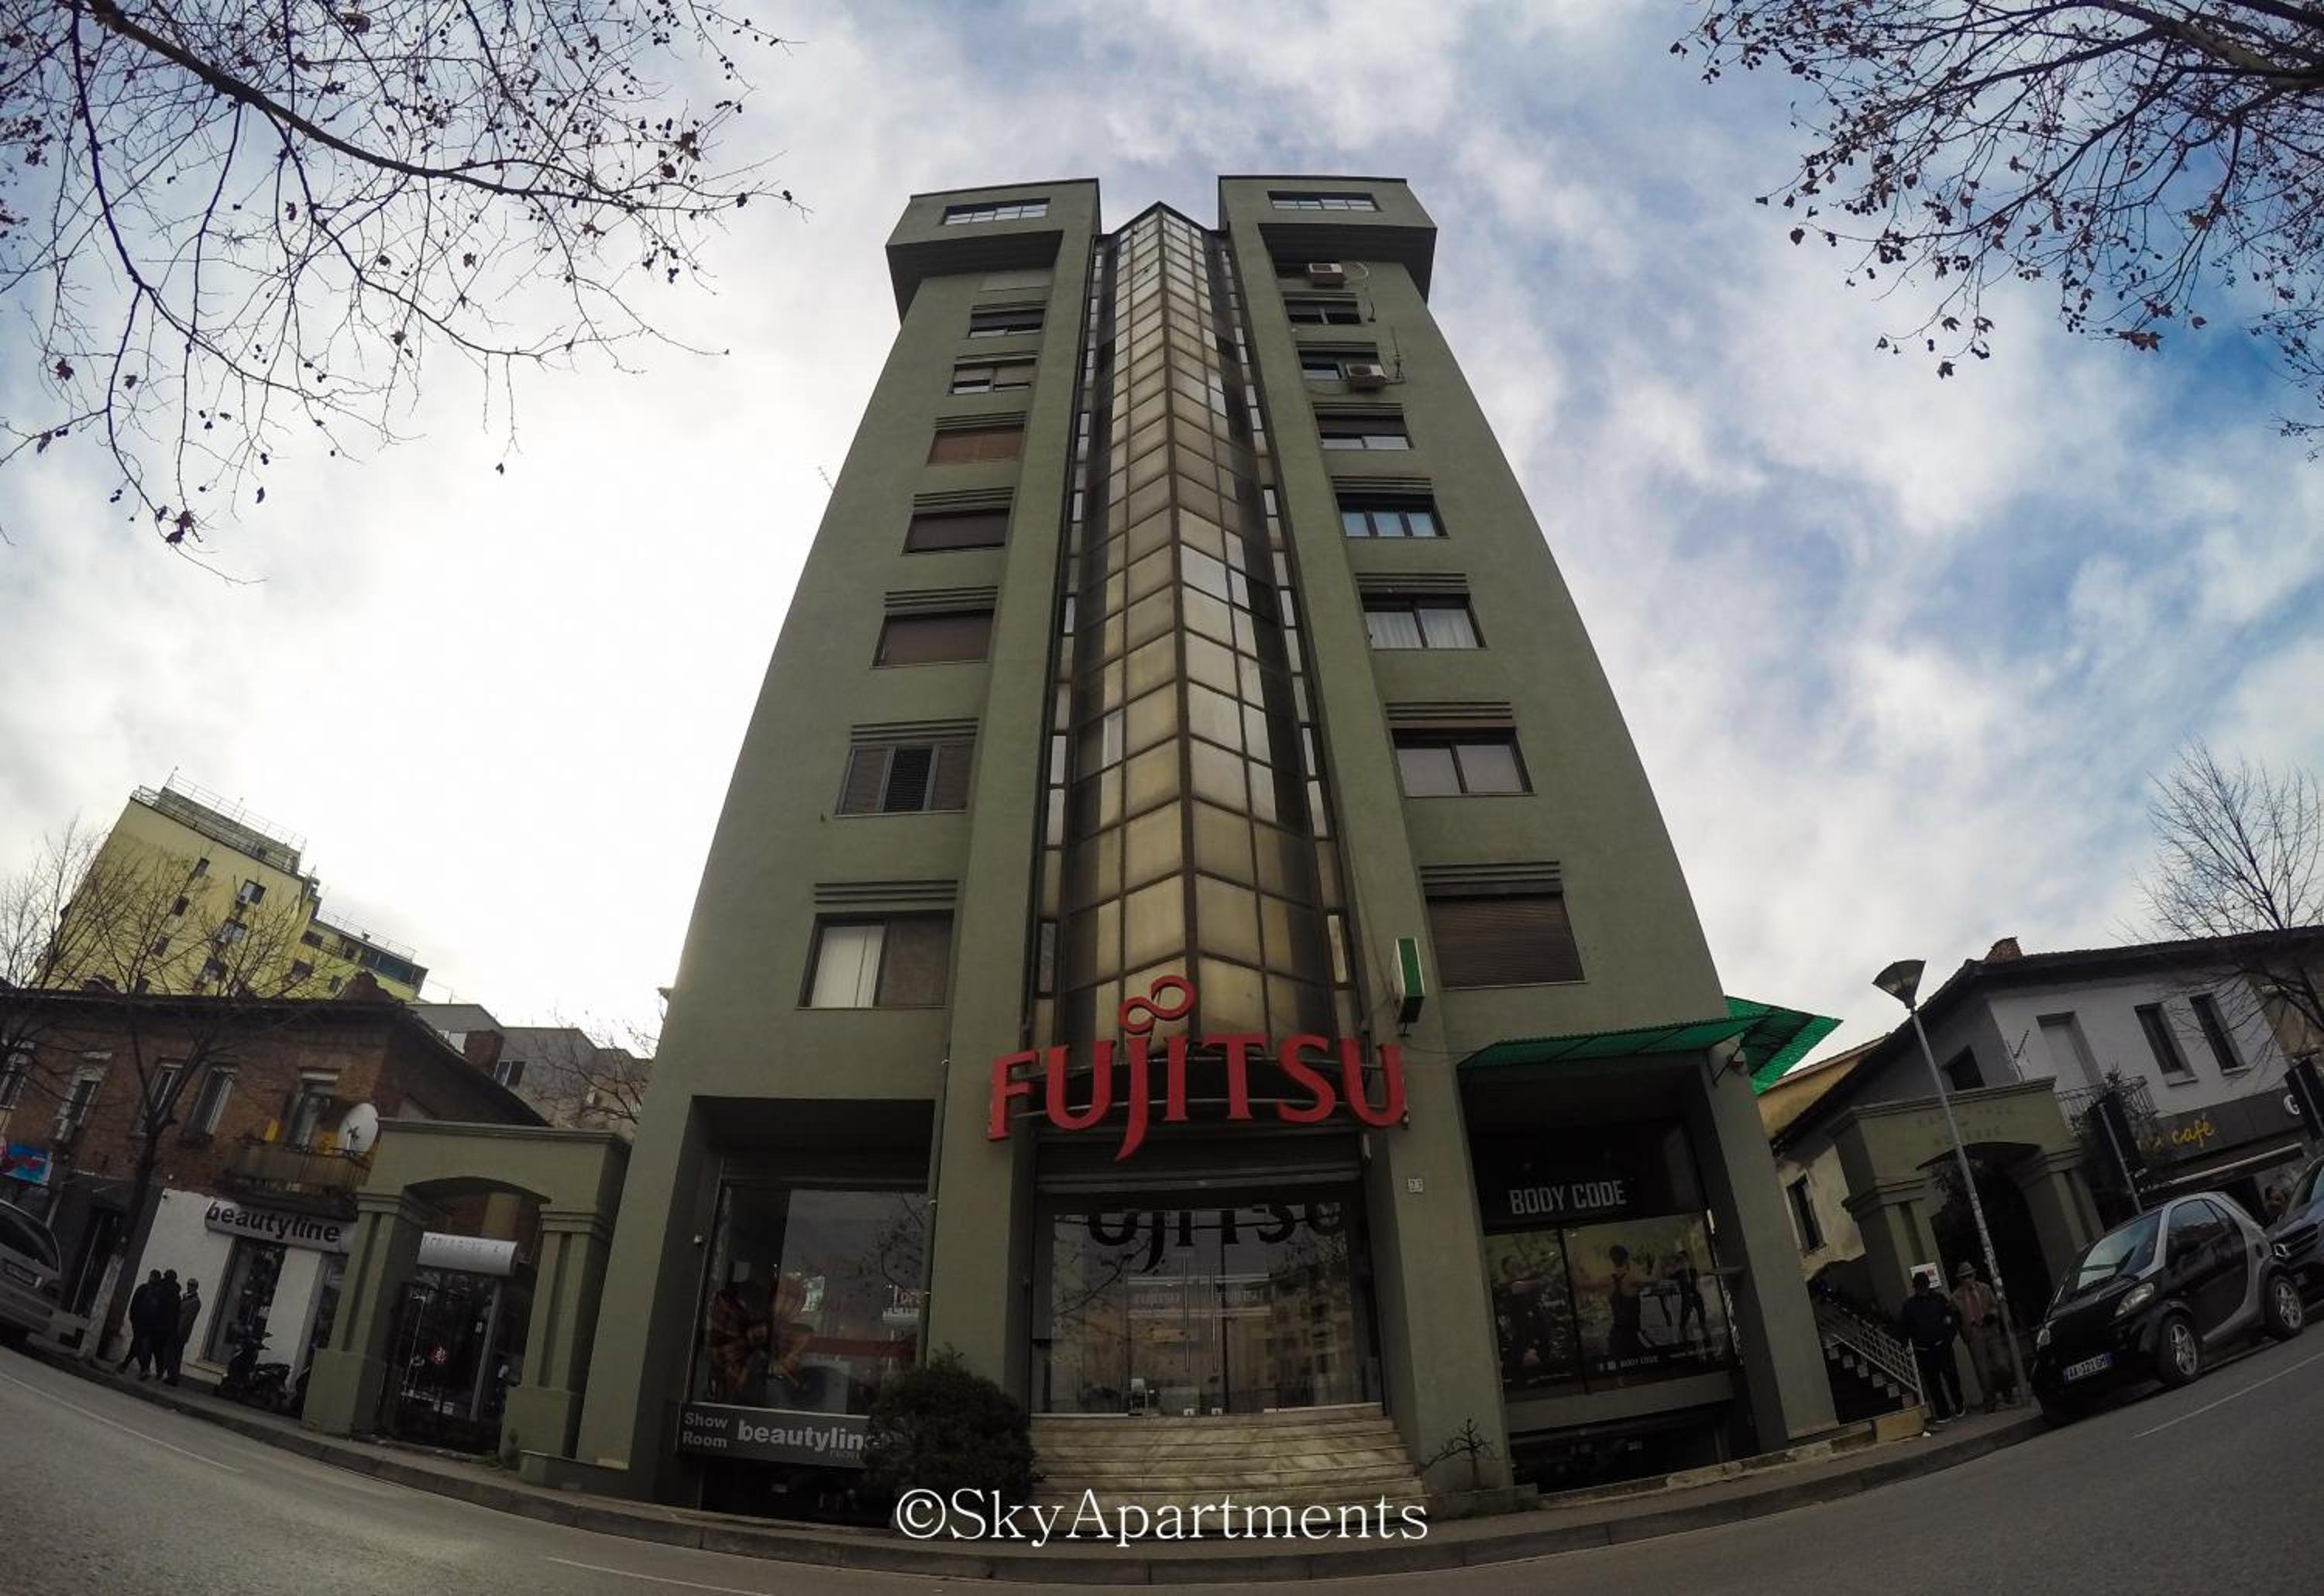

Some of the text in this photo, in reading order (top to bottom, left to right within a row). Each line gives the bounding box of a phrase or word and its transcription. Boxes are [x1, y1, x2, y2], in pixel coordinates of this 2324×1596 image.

[987, 1030, 1408, 1161] FUJITSU
[2171, 1113, 2216, 1148] café
[1509, 1180, 1627, 1215] BODY CODE
[206, 1201, 342, 1243] beautyline
[684, 1412, 728, 1429] Show
[682, 1430, 727, 1449] Room
